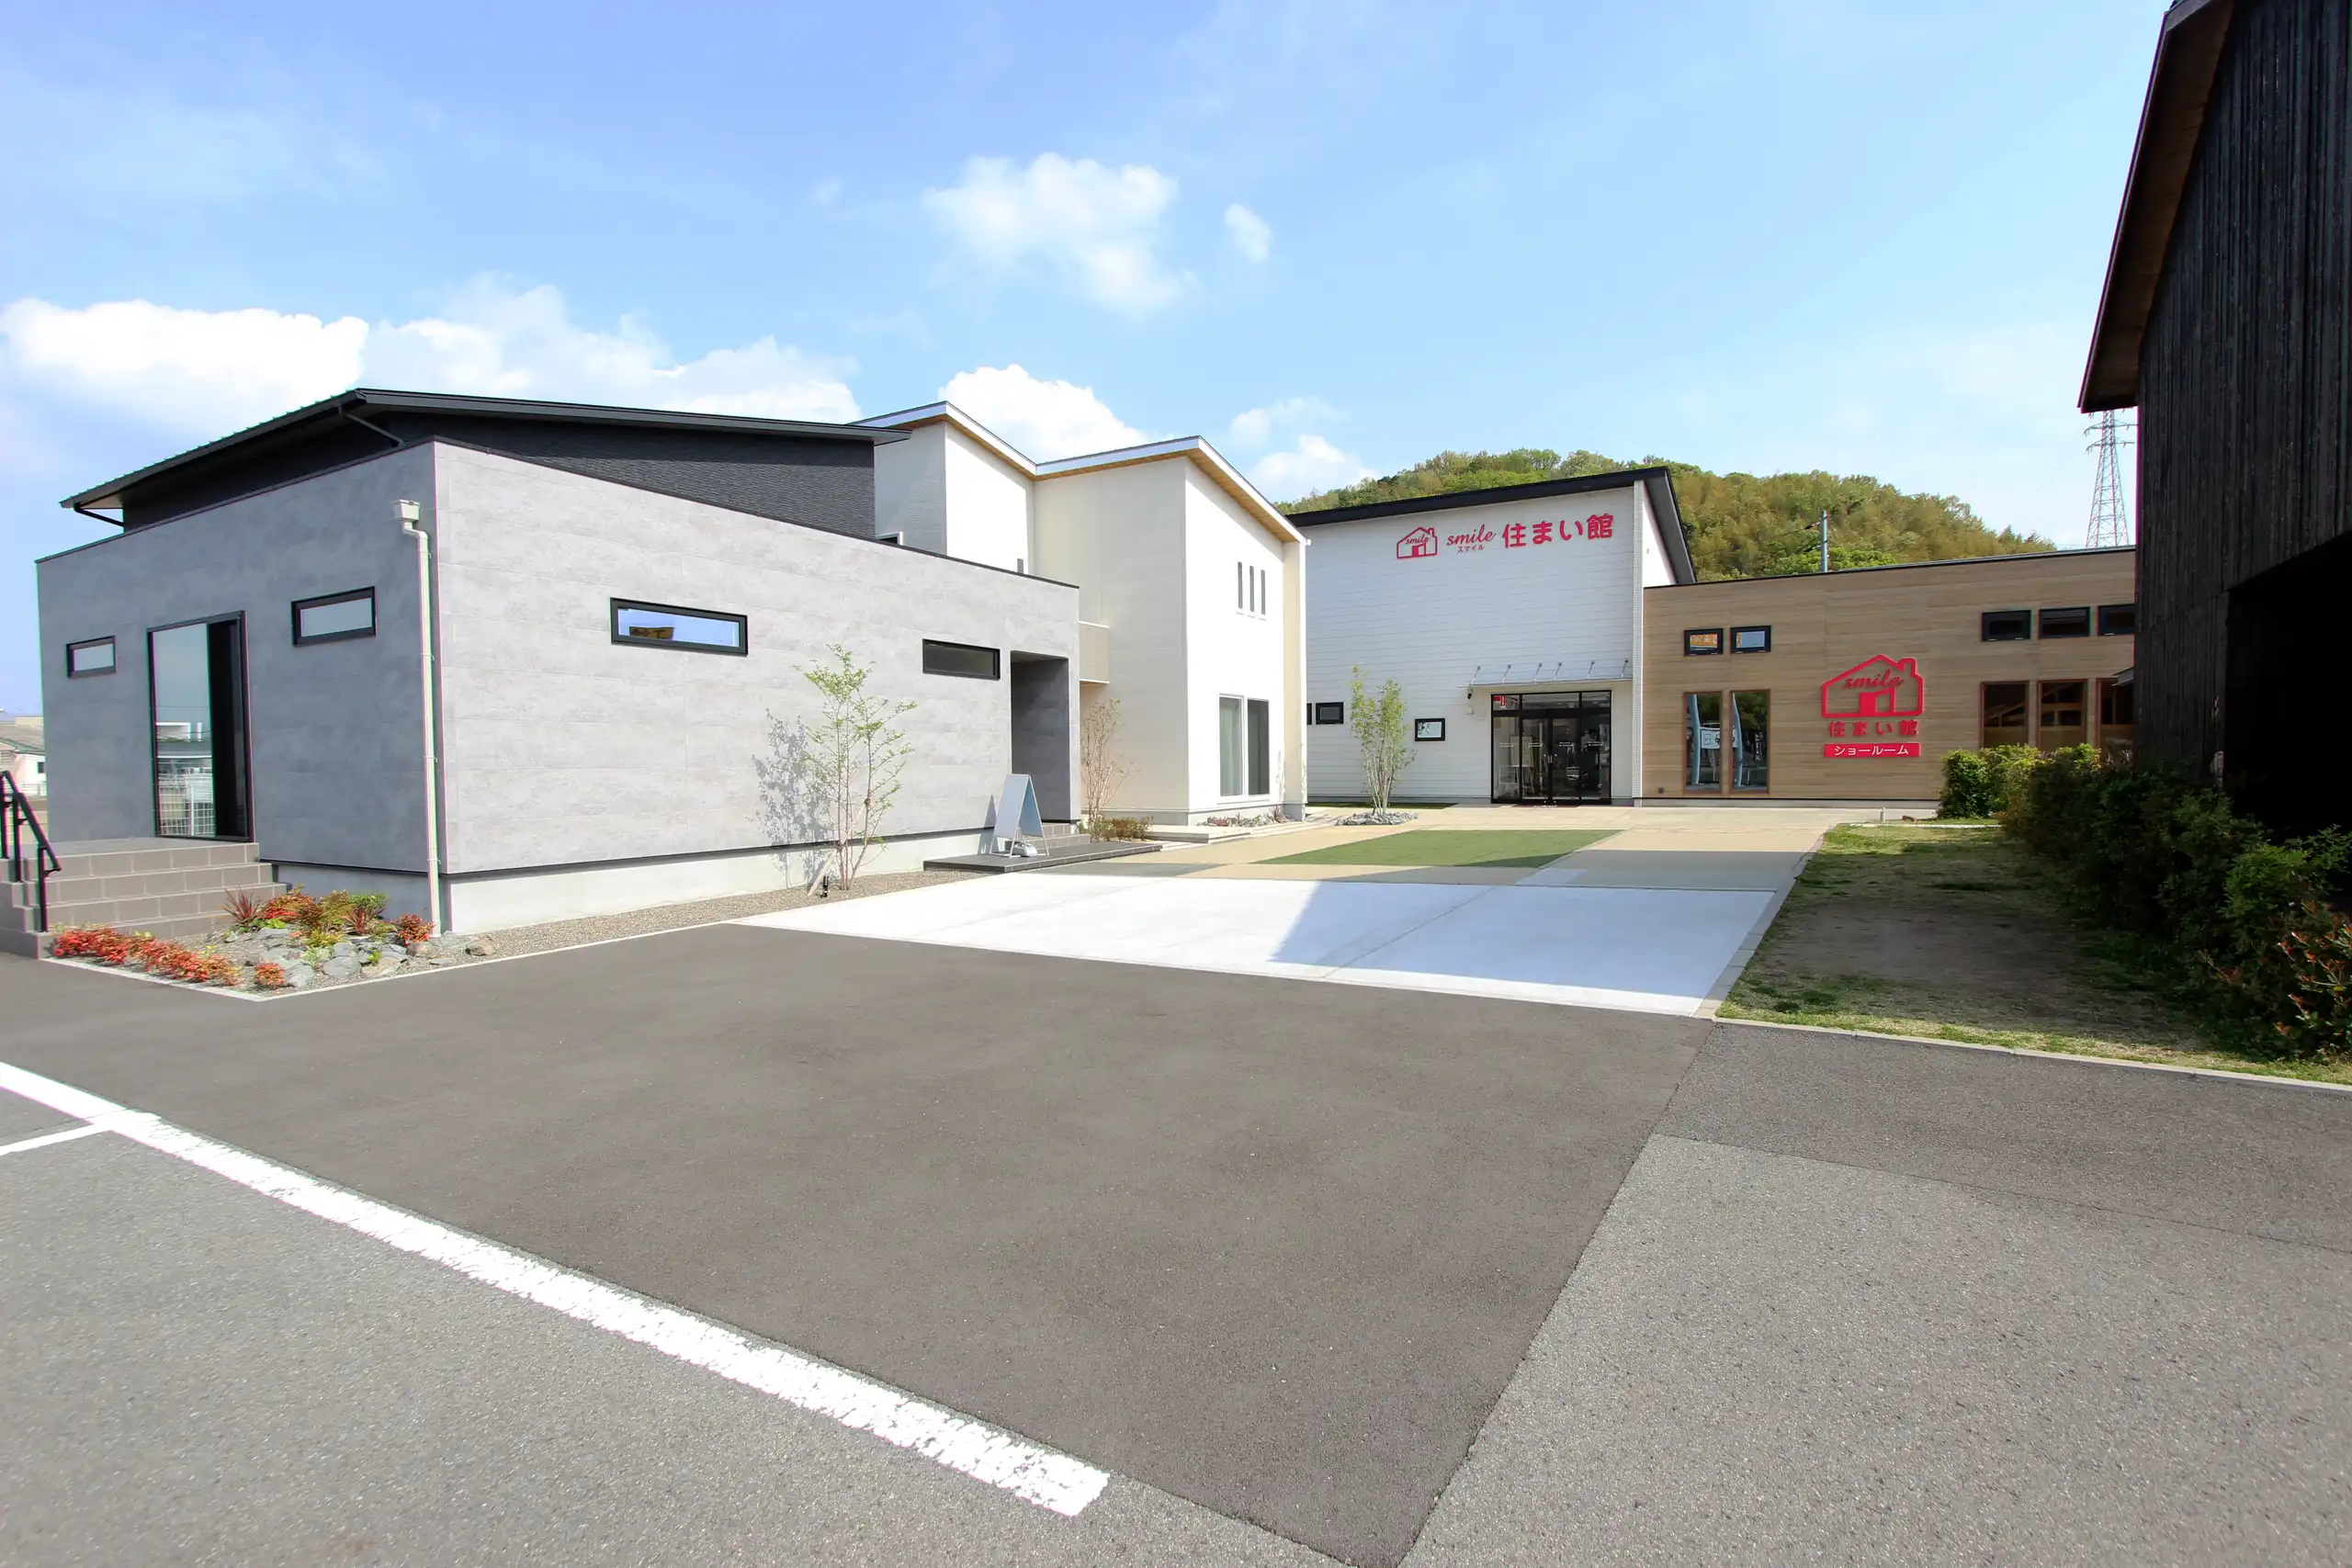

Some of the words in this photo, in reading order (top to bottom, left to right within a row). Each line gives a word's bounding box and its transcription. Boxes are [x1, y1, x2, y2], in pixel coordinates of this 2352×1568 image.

[1446, 524, 1496, 546] smile
[1501, 513, 1614, 548] 住まい館
[1406, 533, 1429, 545] smile
[1457, 544, 1485, 553] スマイル
[1844, 668, 1905, 688] smile
[1834, 745, 1909, 756] ショールーム
